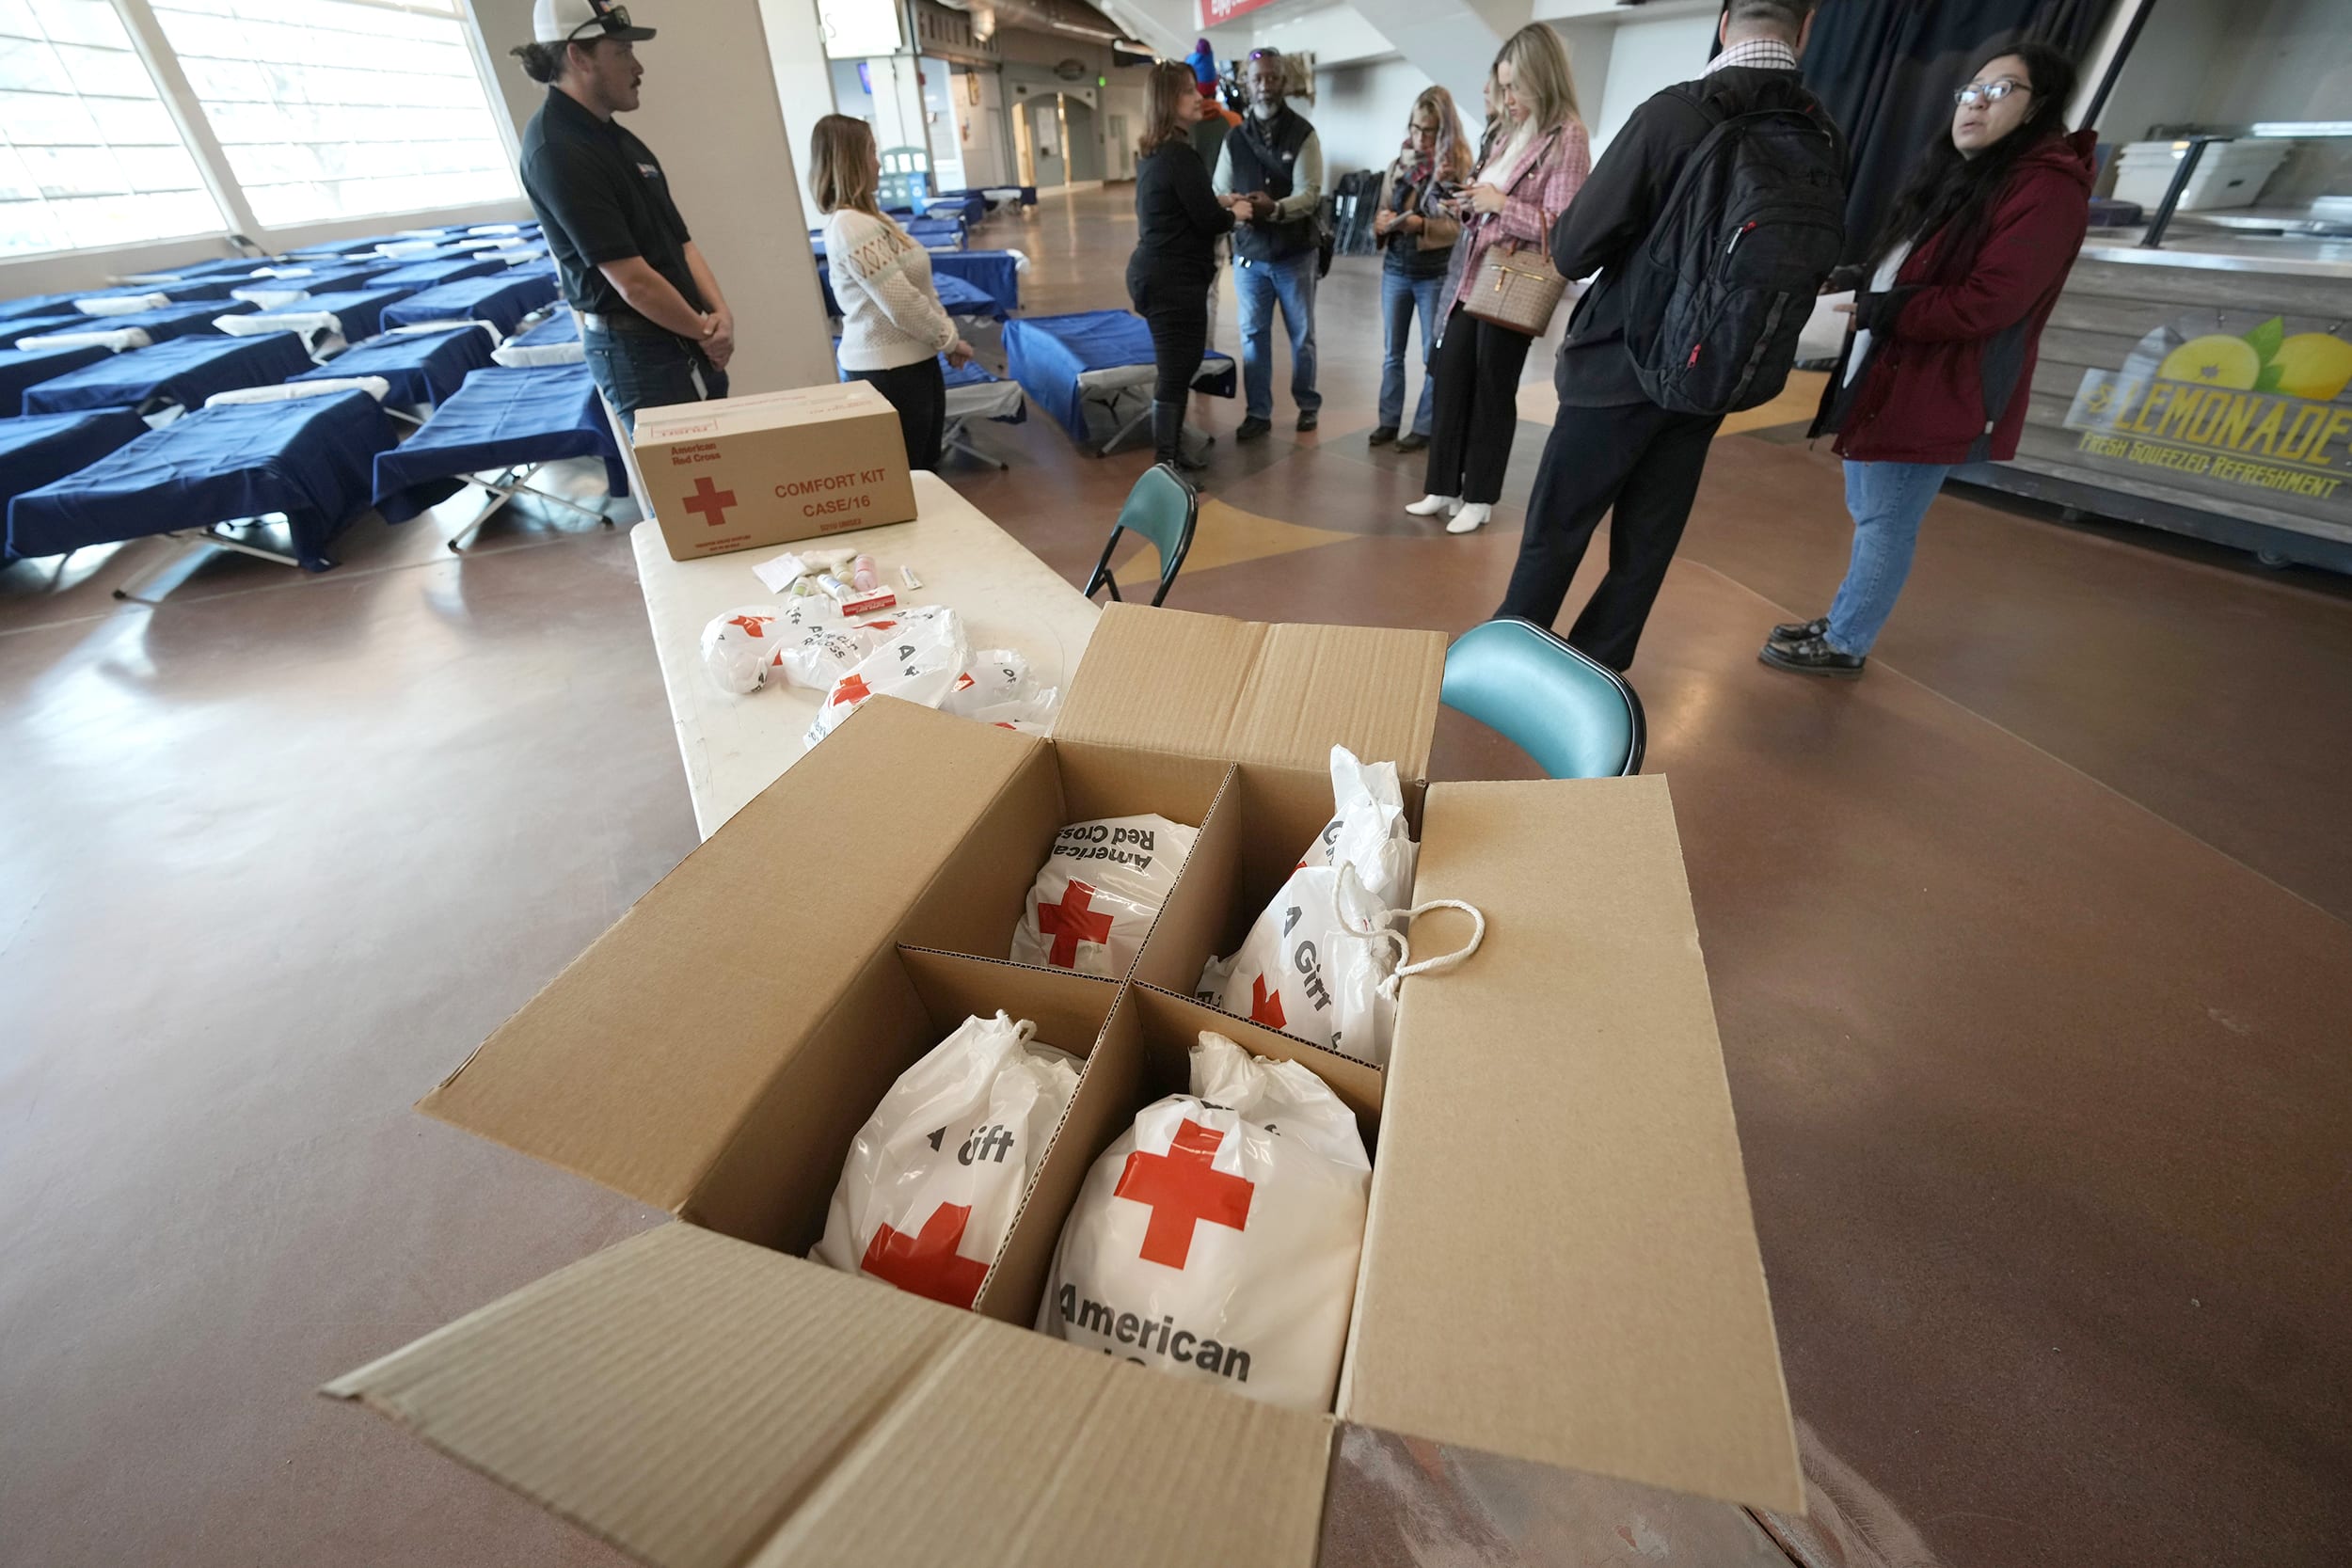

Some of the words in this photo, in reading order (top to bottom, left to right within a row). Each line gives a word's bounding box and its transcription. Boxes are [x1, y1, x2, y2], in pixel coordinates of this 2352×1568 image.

[2113, 380, 2352, 466] LEMONADE
[671, 442, 717, 455] American
[672, 454, 692, 466] Red
[692, 452, 722, 463] Cross
[2077, 431, 2129, 459] FRESH
[2127, 441, 2210, 475] SQUEEZED
[2208, 456, 2343, 499] REFRESHMENT
[774, 472, 856, 499] COMFORT
[860, 468, 886, 484] KIT
[803, 495, 871, 517] CASE/16
[1111, 828, 1155, 851] Red
[1053, 844, 1153, 873] America
[1059, 1282, 1251, 1383] American
